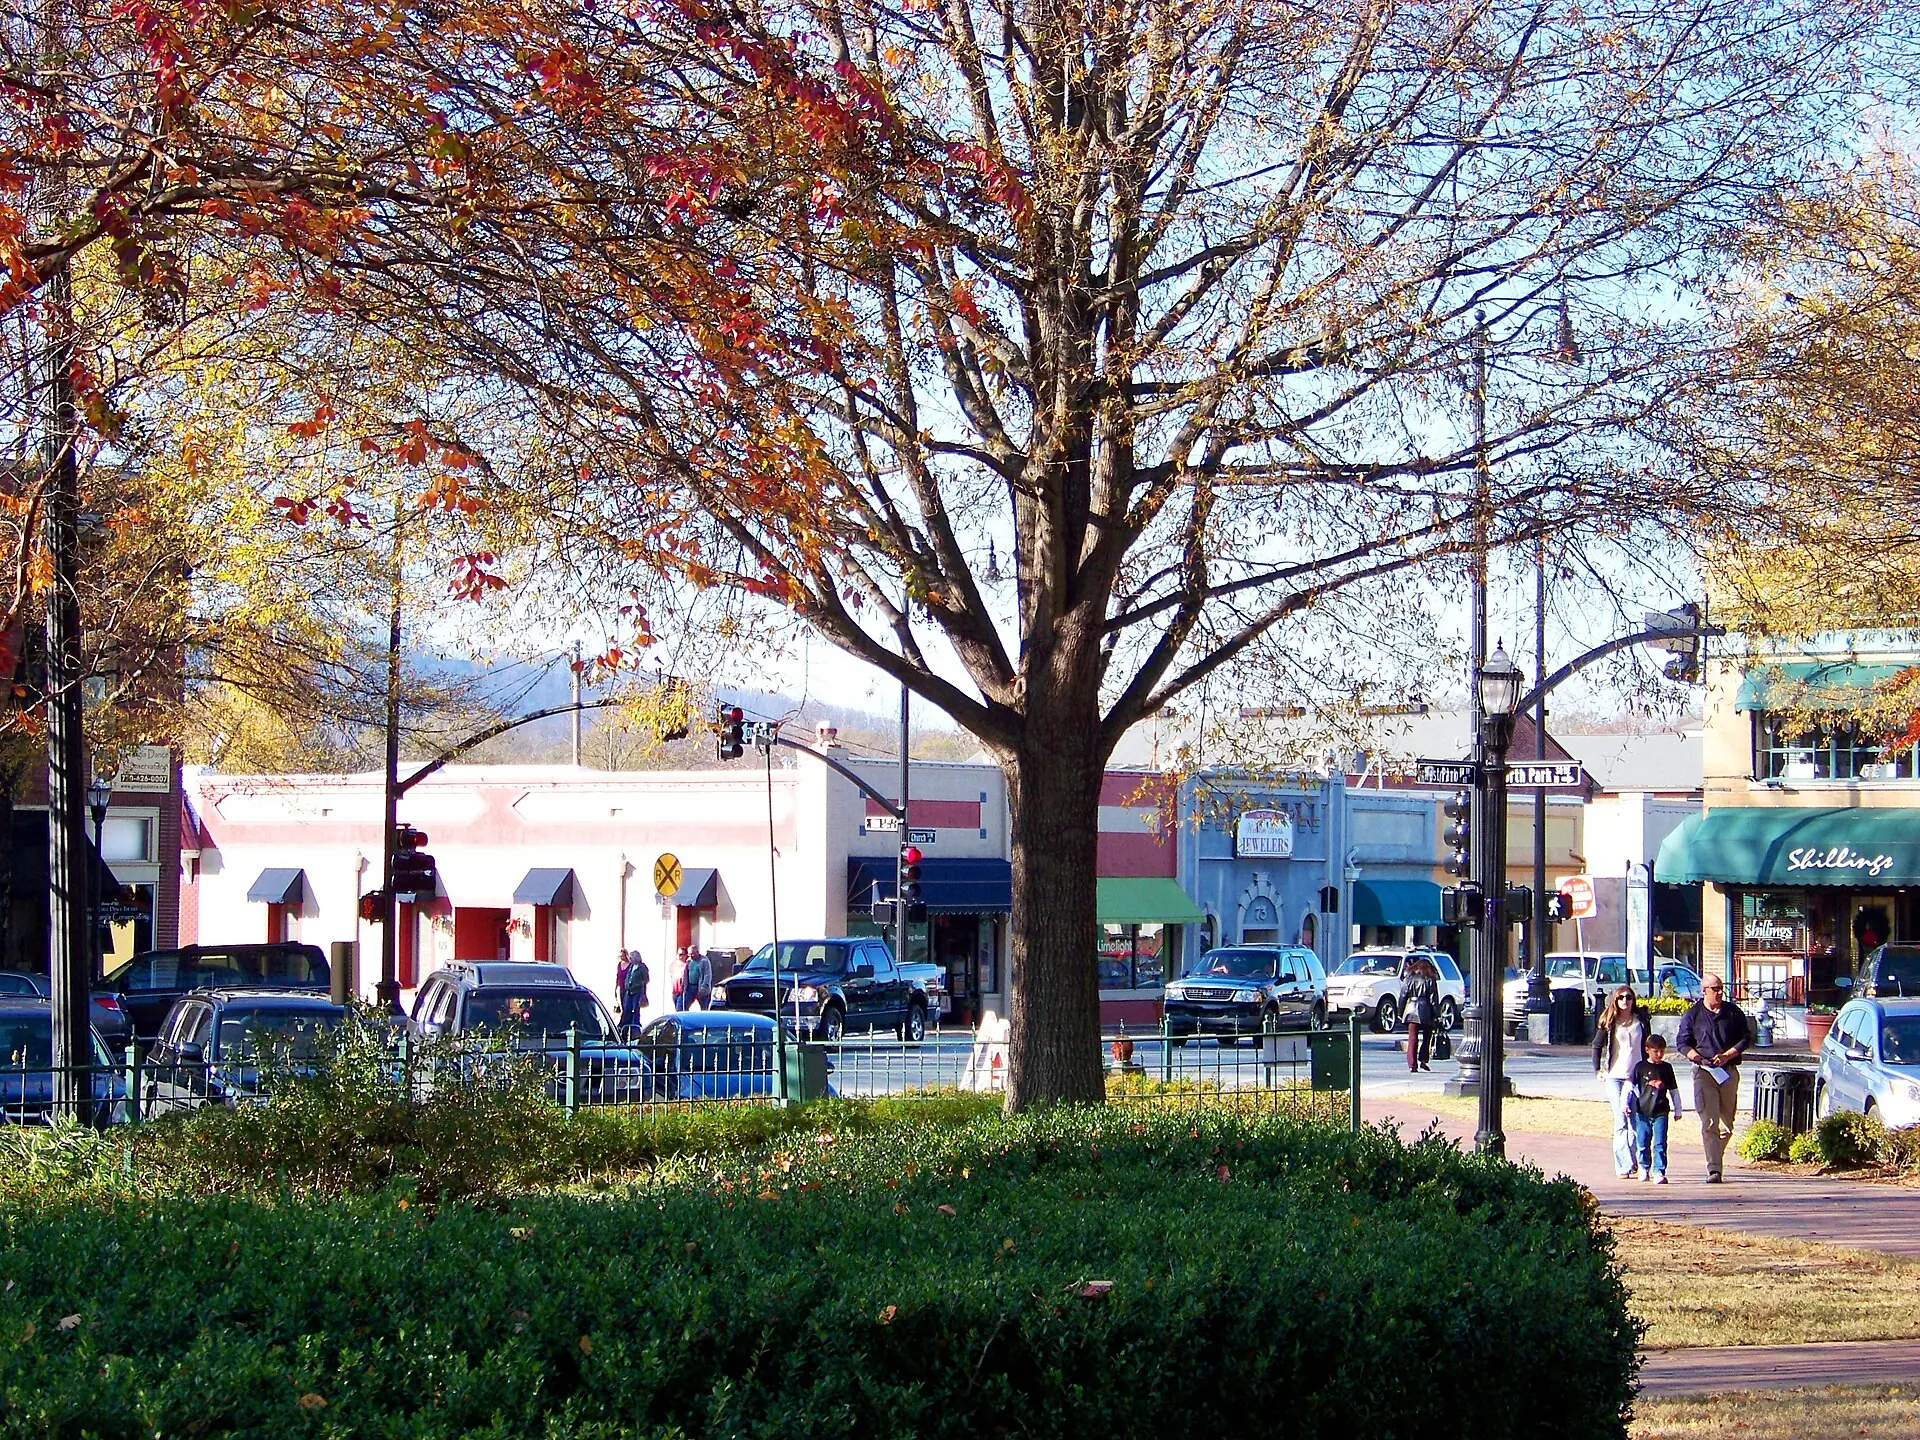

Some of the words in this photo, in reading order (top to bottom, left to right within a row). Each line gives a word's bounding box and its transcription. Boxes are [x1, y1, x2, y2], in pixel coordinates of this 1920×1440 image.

[147, 748, 168, 759] Dance
[121, 774, 168, 783] 70-426-0007
[1505, 767, 1526, 784] orth
[1528, 767, 1552, 784] Park
[1242, 837, 1289, 853] JEWELERS
[1787, 847, 1894, 876] Shillings
[1572, 901, 1588, 910] TER
